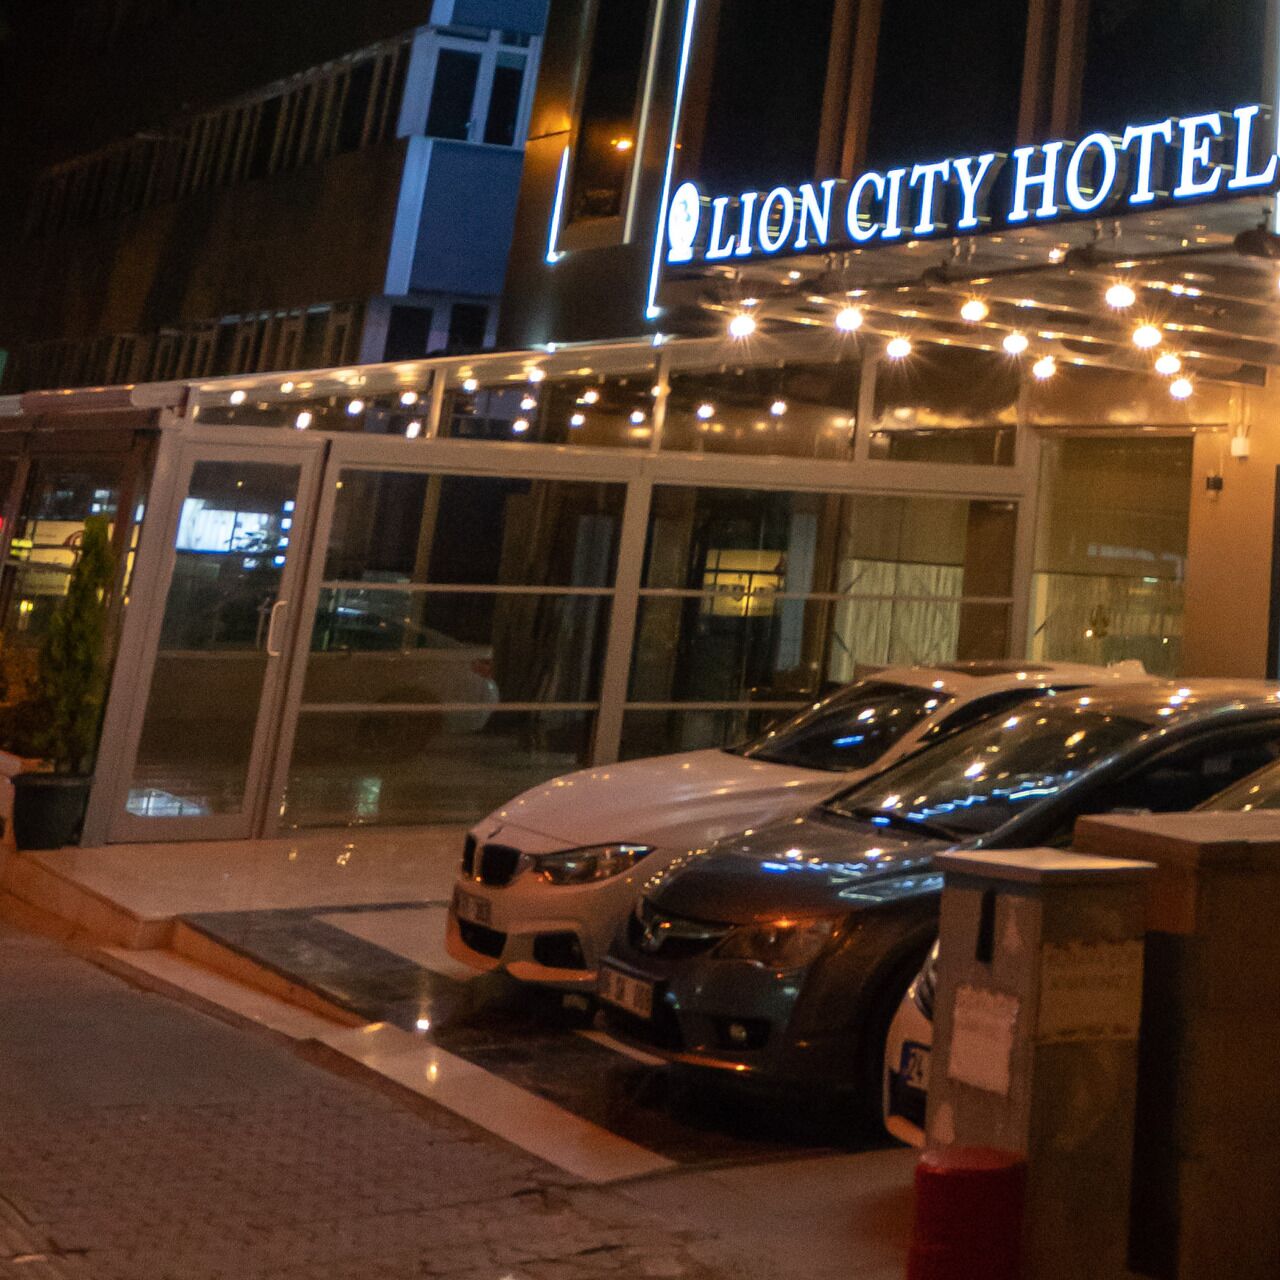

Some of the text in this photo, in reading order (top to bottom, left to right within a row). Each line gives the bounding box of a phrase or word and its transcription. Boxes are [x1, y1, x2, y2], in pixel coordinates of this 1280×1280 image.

[704, 104, 1278, 261] LION CITY HOTEL
